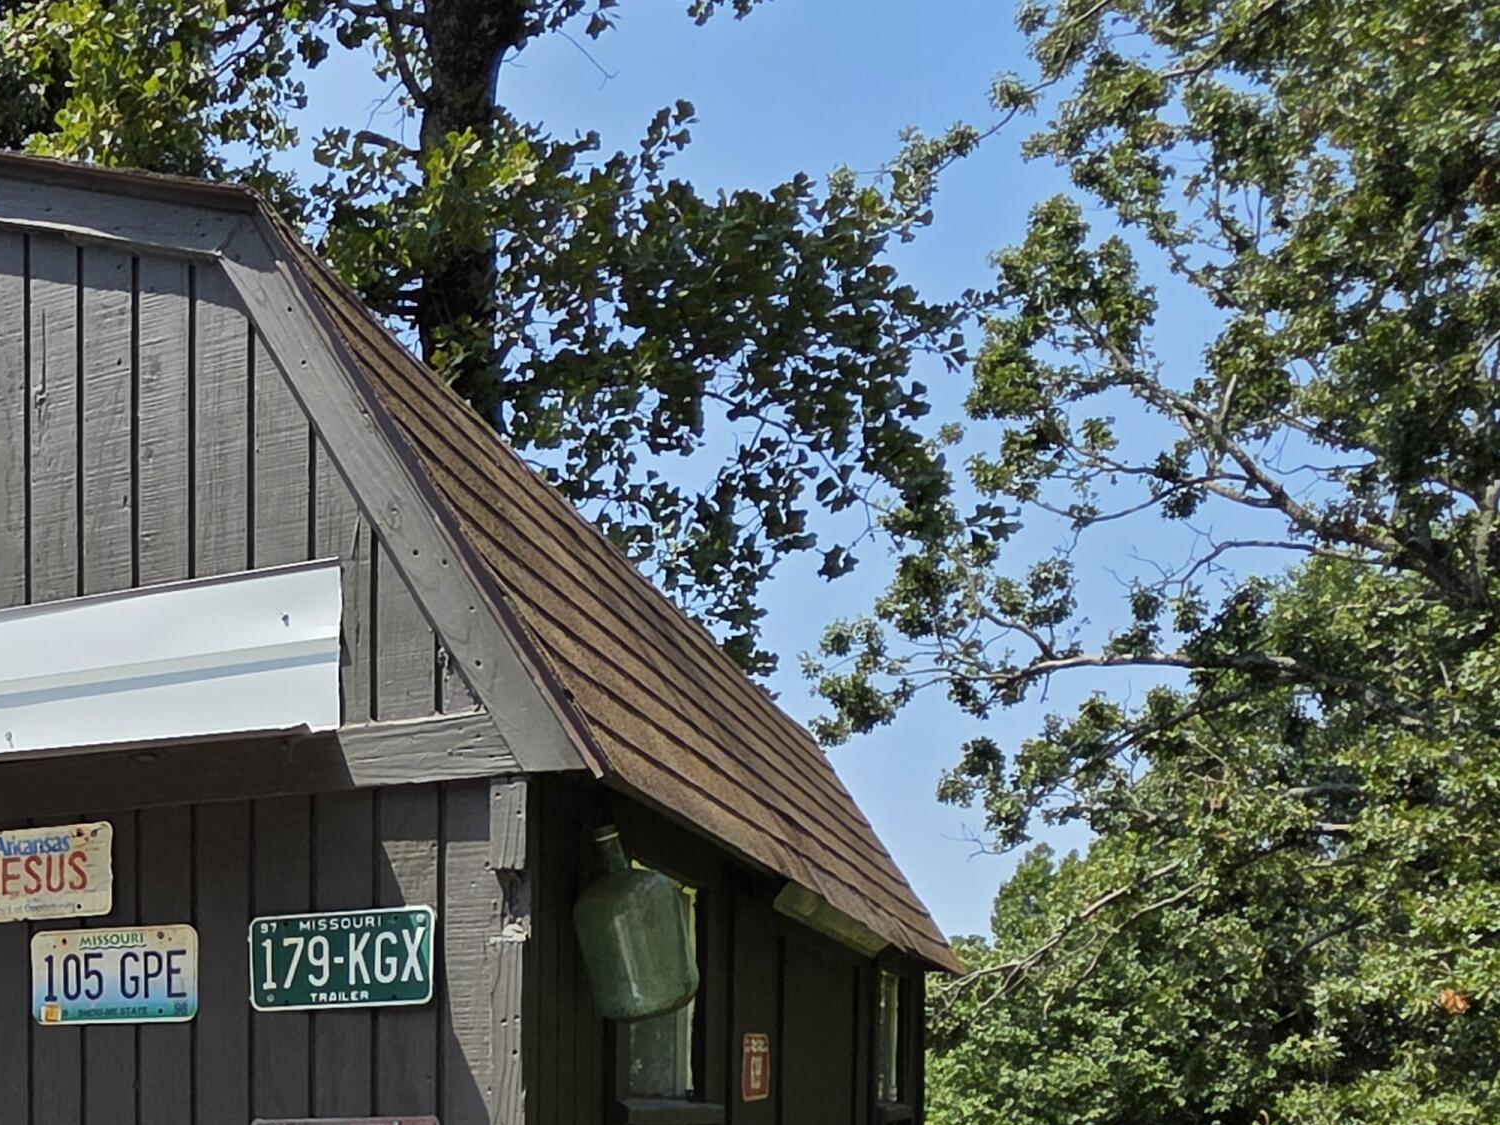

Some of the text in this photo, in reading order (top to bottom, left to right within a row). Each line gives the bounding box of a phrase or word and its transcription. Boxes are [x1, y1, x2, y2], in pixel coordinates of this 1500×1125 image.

[260, 916, 382, 934] 97 MISSOURI
[79, 932, 144, 947] MISSOURI
[261, 927, 427, 990] 179-KGX
[44, 949, 187, 1002] 105 GPE
[309, 990, 369, 1003] TRAILER
